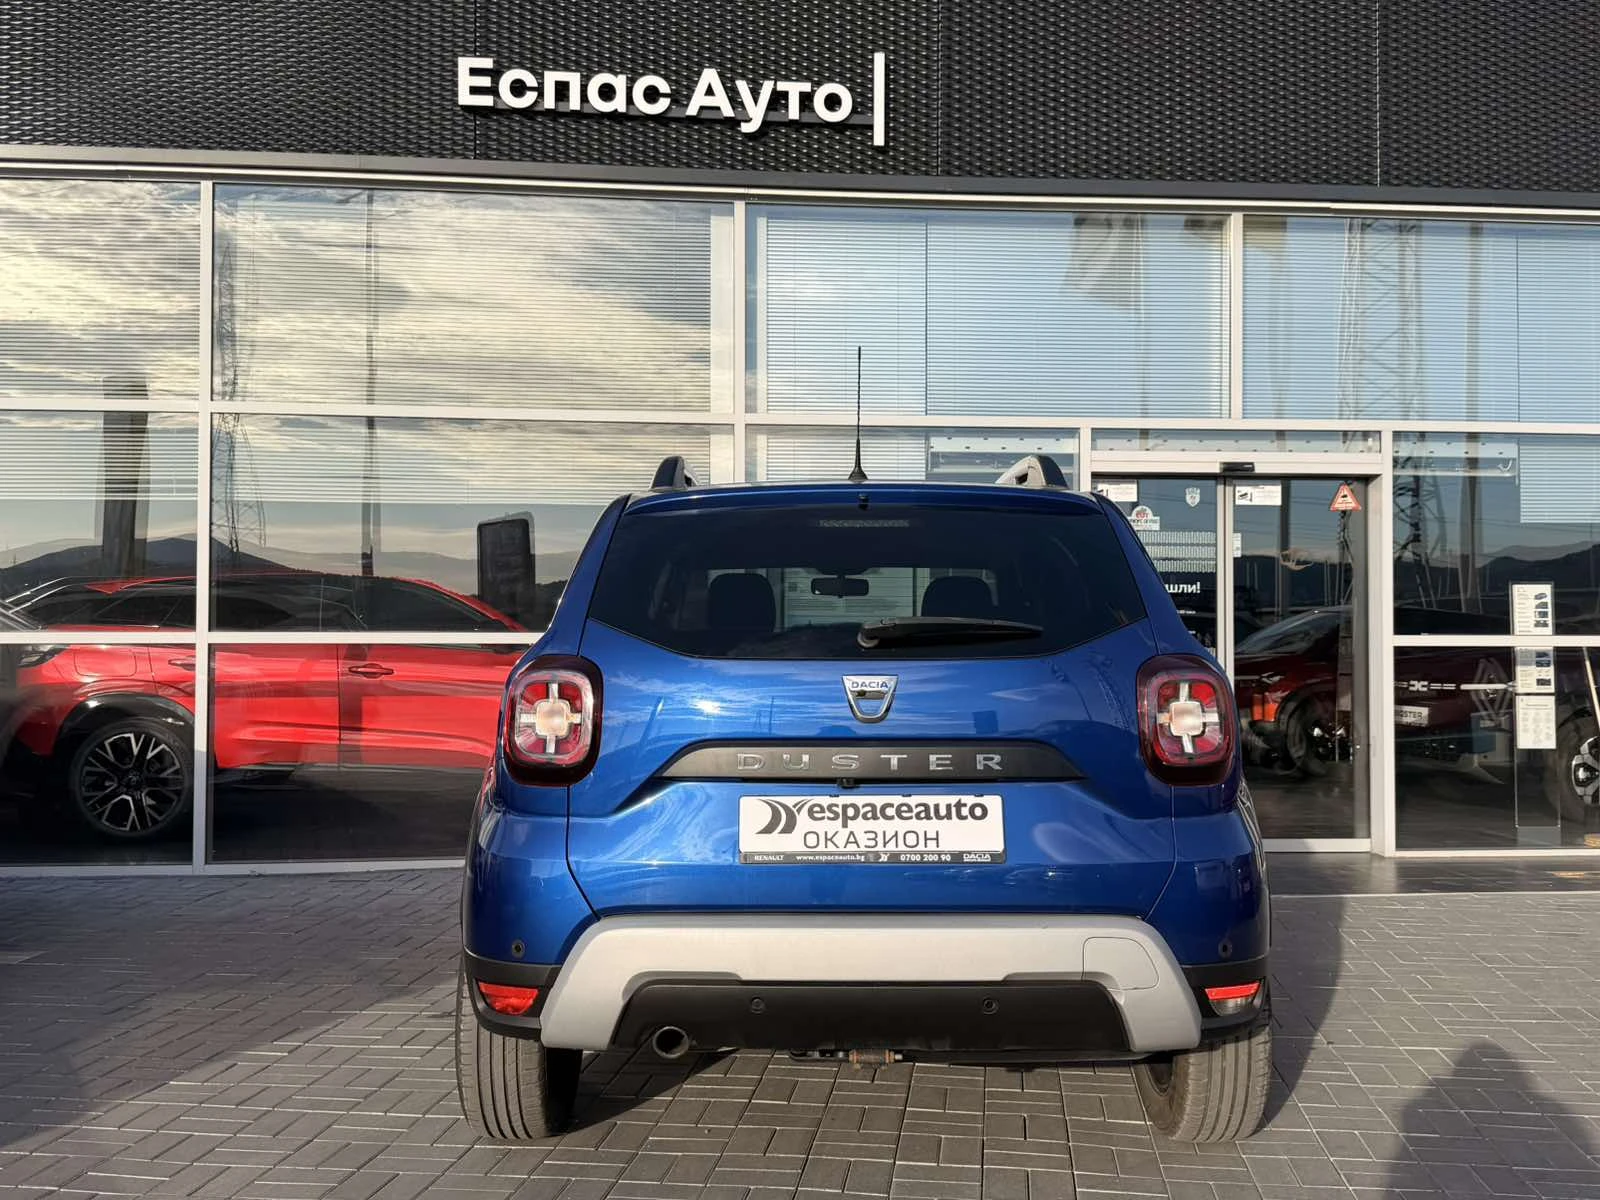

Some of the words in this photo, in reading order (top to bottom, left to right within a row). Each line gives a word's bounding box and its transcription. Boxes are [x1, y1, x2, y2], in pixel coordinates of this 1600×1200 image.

[457, 56, 671, 115] Еспас
[685, 67, 853, 134] Ауто
[851, 681, 889, 689] DACIA
[736, 753, 1003, 771] DUSTER
[807, 798, 989, 829] espaceauto
[802, 830, 940, 849] ОКАЗИОН
[900, 853, 920, 861] 0700
[922, 853, 939, 861] 200
[940, 853, 952, 861] 90
